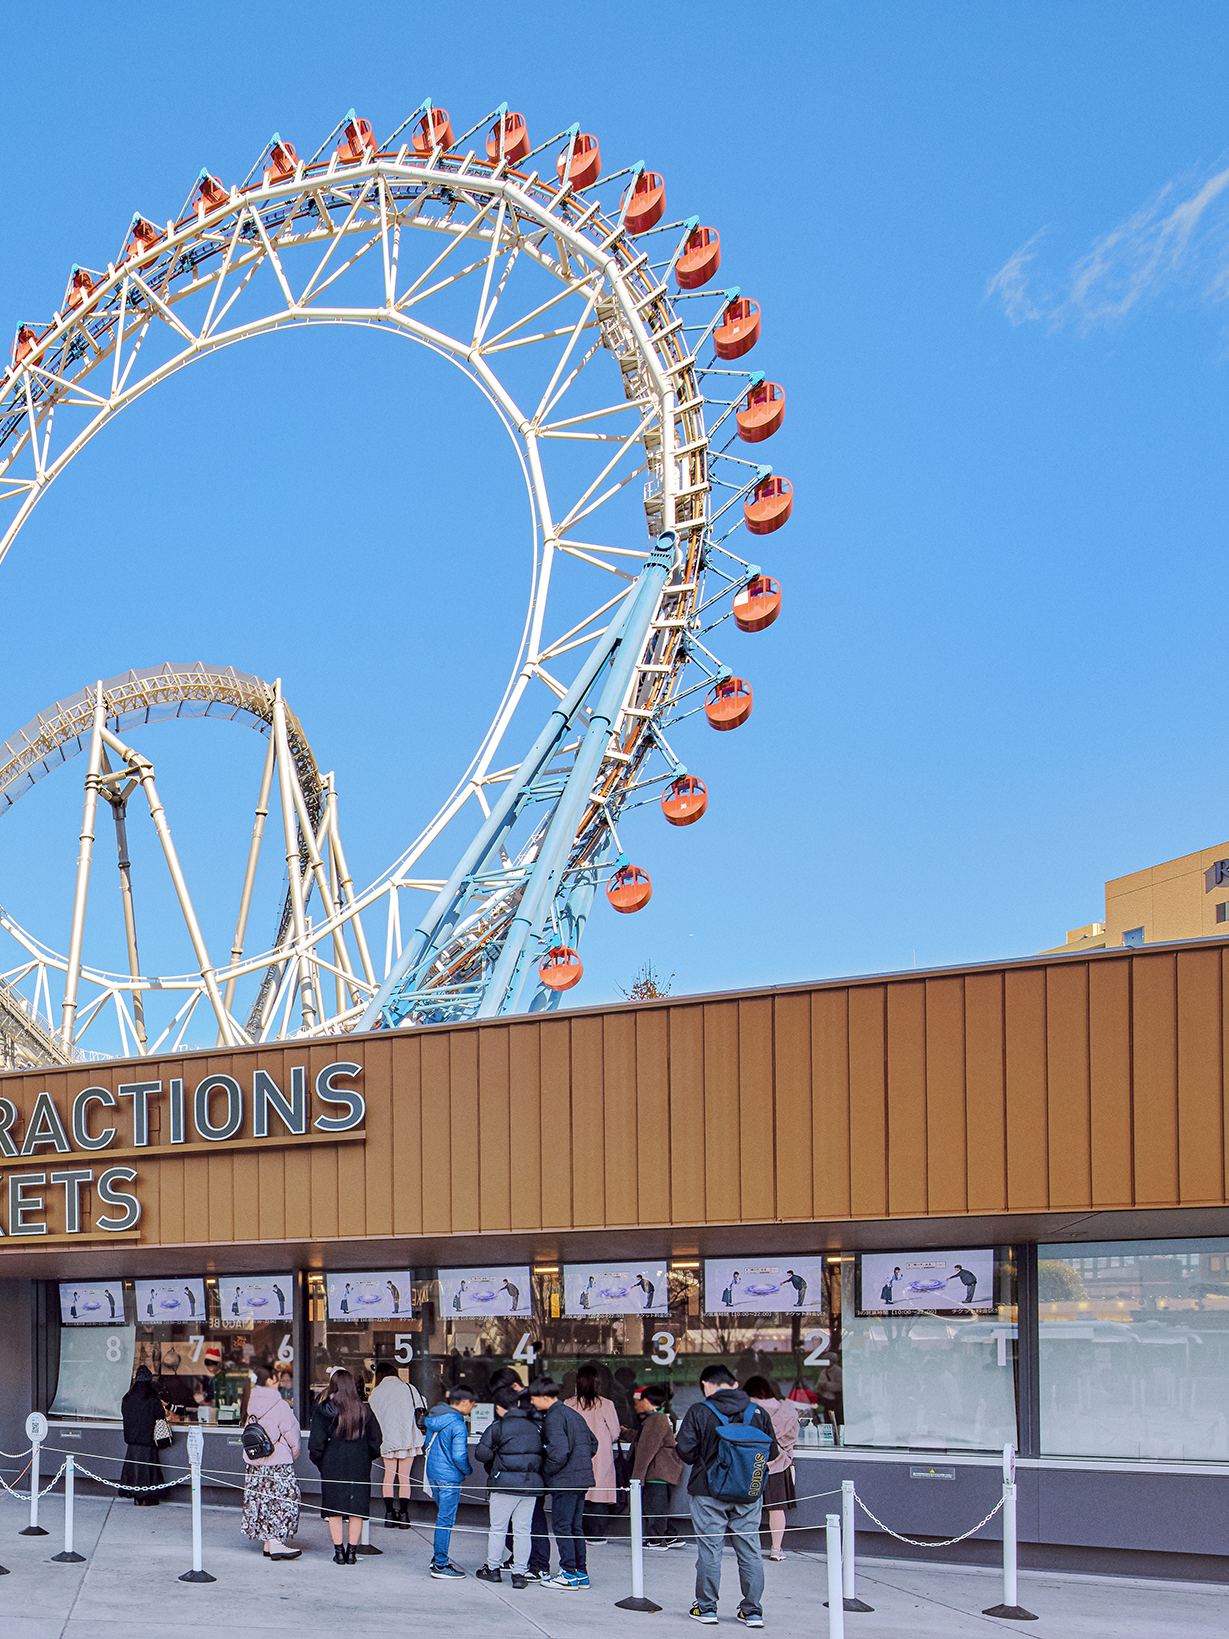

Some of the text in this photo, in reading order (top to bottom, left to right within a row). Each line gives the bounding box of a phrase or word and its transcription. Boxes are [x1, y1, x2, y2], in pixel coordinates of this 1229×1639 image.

[105, 1336, 122, 1362] 8
[189, 1335, 205, 1362] 7
[277, 1334, 294, 1363] 6
[394, 1333, 414, 1364] 5
[512, 1332, 537, 1365] 4
[650, 1331, 676, 1366] 3
[803, 1330, 831, 1367] 2
[991, 1329, 1007, 1366] 1
[748, 1453, 767, 1497] ADIDAS
